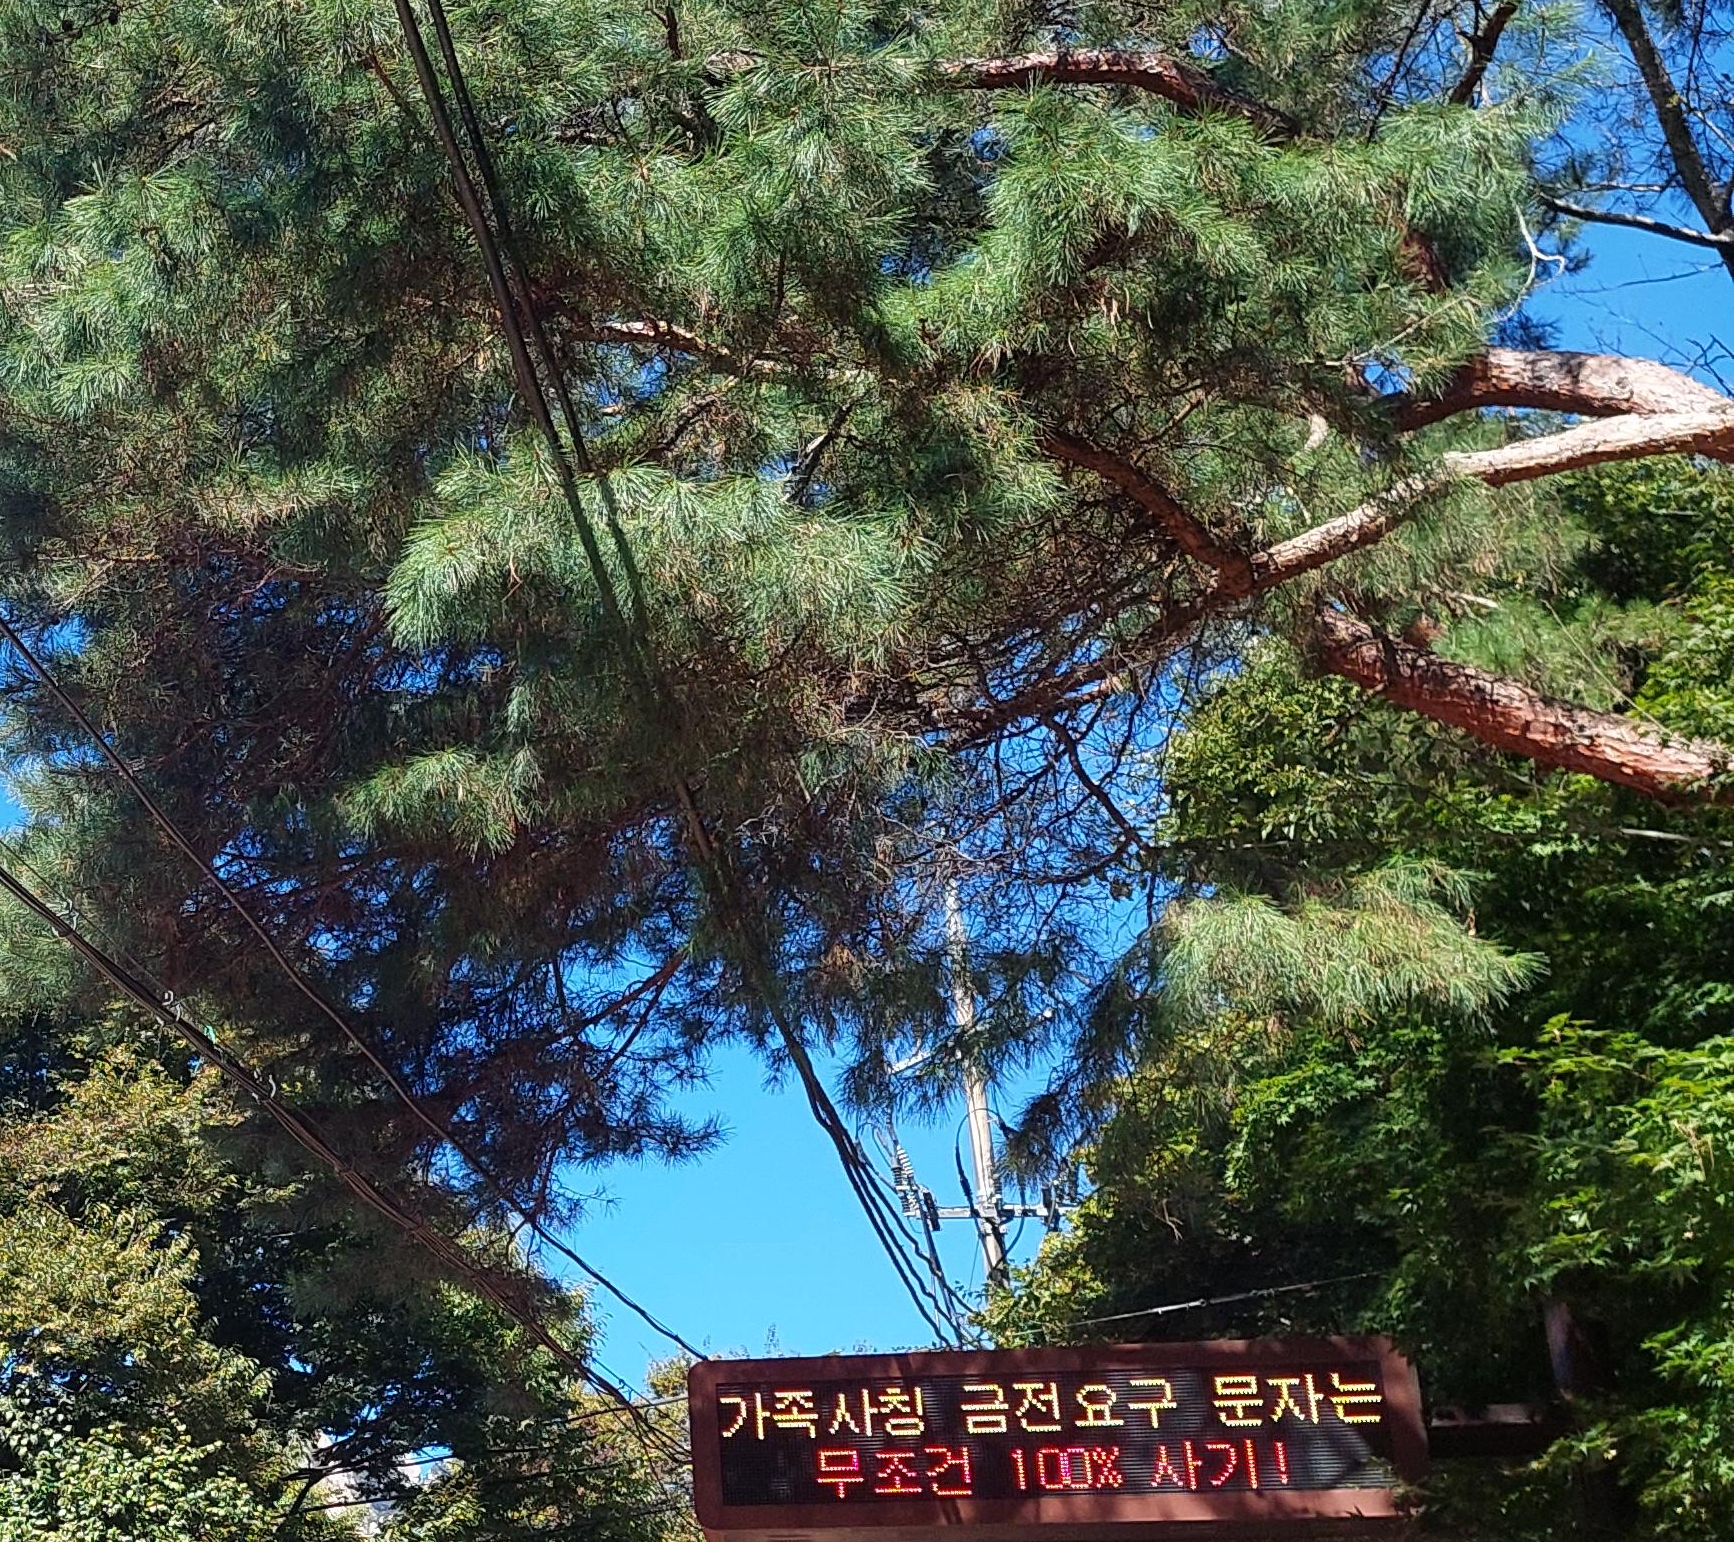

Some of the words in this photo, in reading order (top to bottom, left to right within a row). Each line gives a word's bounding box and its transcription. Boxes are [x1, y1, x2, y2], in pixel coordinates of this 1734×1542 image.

[719, 1386, 926, 1440] 가족사칭
[960, 1378, 1178, 1434] 금전요구
[1212, 1372, 1383, 1427] 문자는
[817, 1446, 972, 1497] 무조건
[1011, 1445, 1123, 1490] 100%
[1150, 1439, 1289, 1490] 사기!
